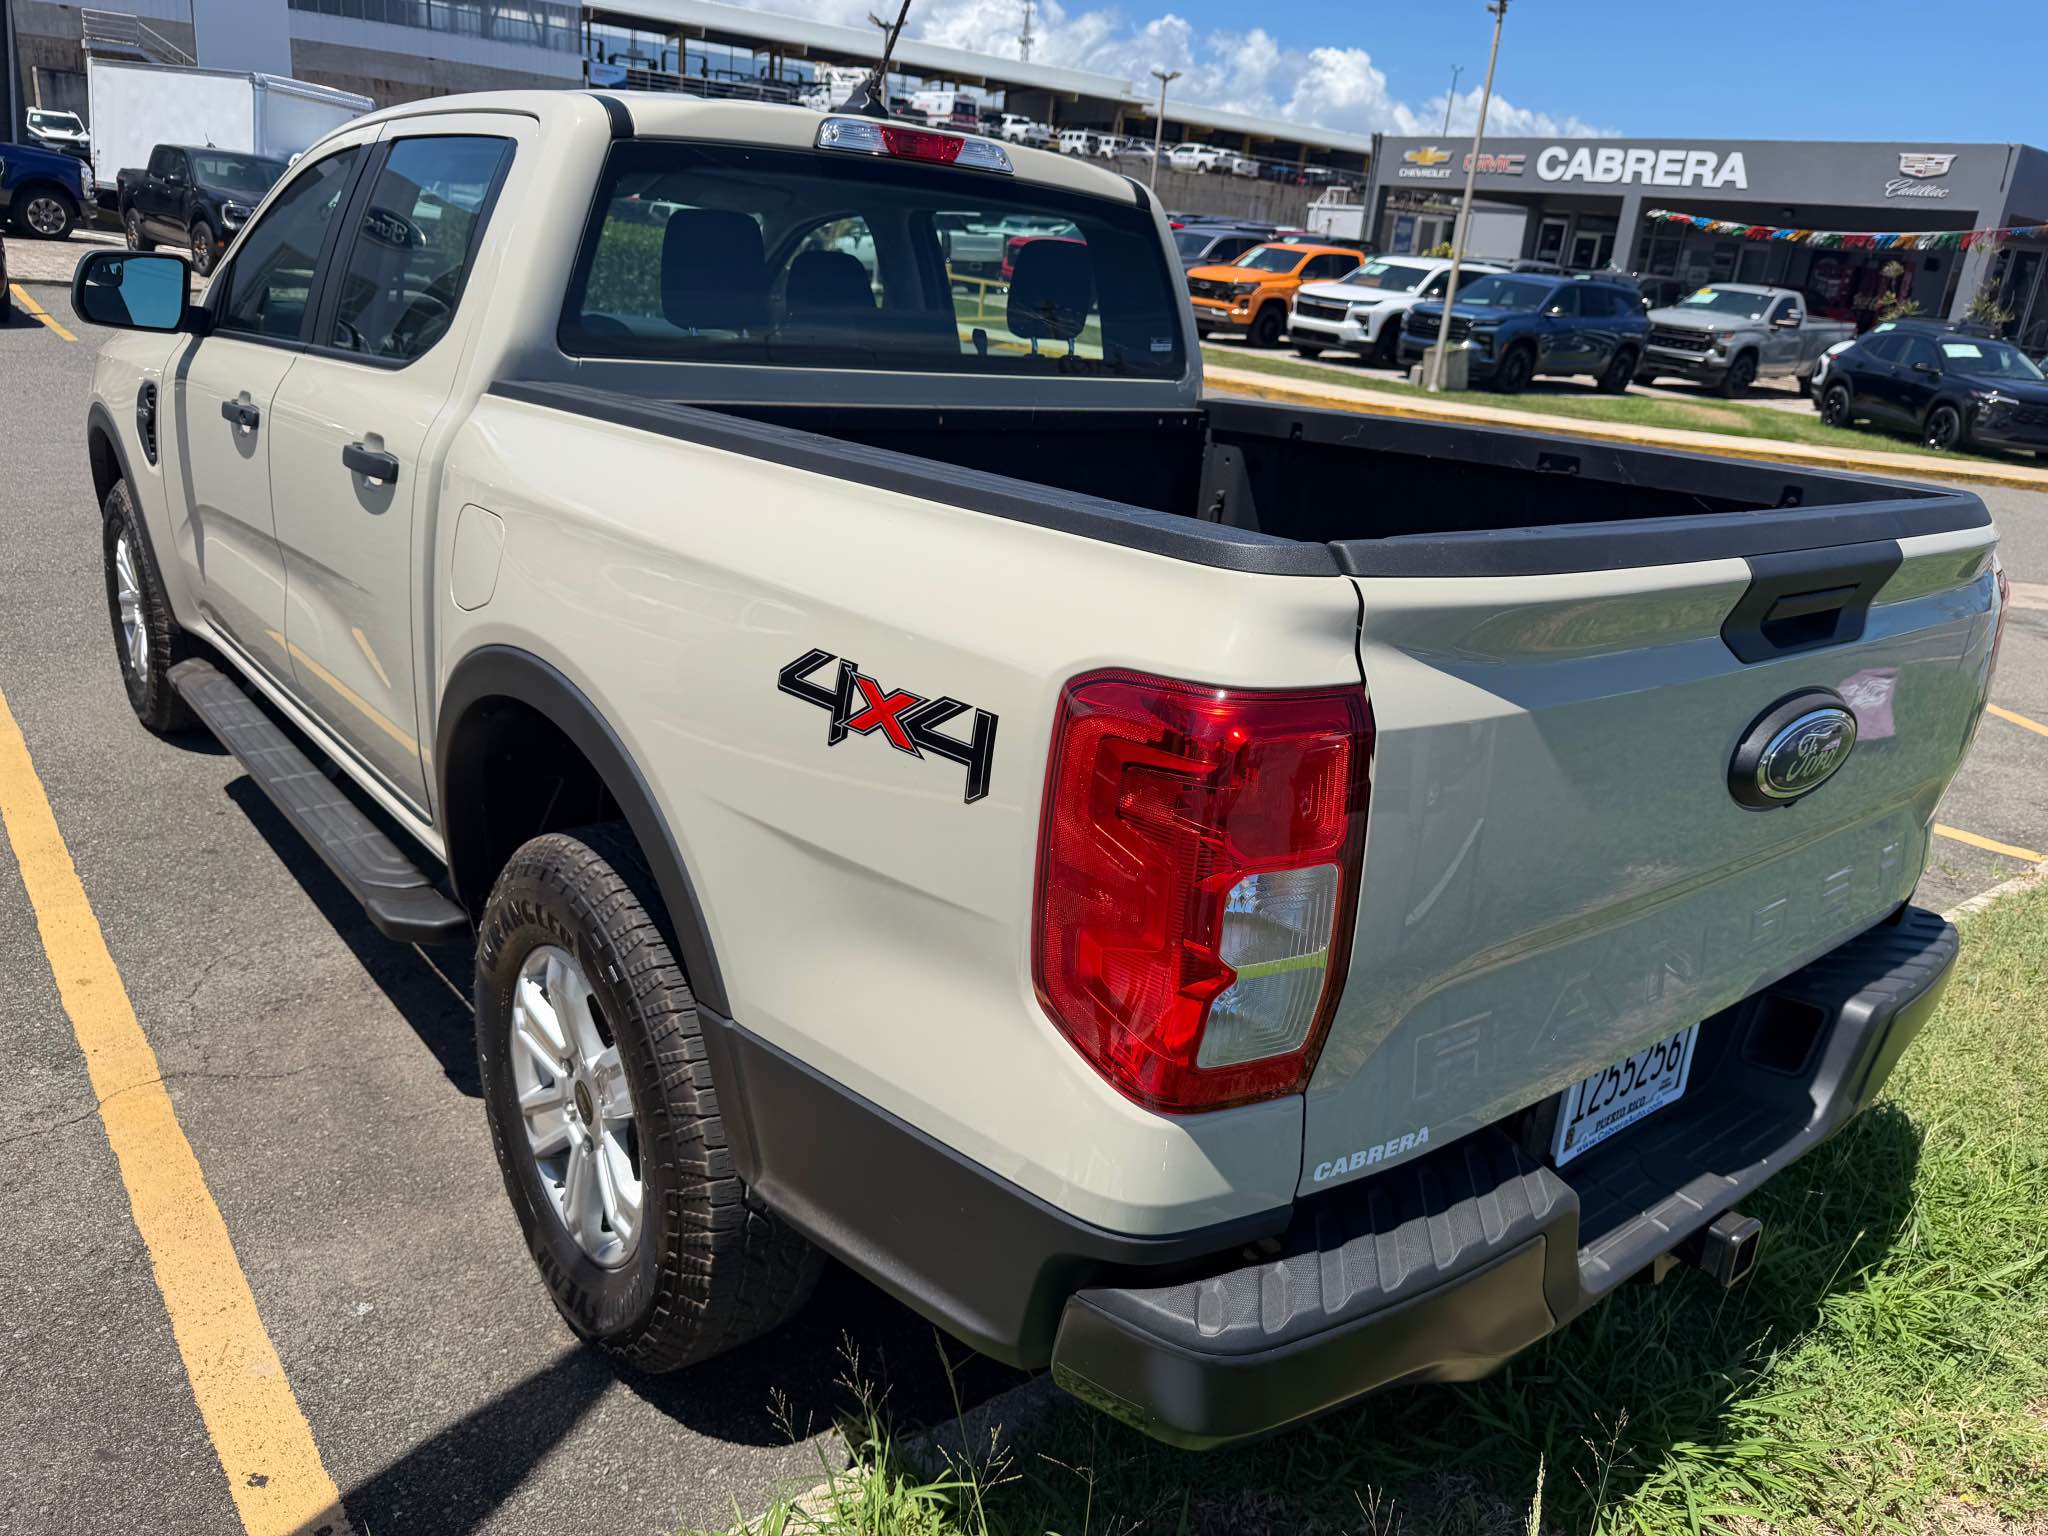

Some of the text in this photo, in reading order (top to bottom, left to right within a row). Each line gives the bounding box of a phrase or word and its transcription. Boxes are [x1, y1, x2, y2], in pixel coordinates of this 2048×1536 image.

[1398, 168, 1452, 179] CHEVROLET
[1536, 146, 1748, 189] CABRERA
[1885, 178, 1949, 198] Cadillac
[1785, 731, 1843, 782] Ford
[1313, 1126, 1430, 1182] CABRERA
